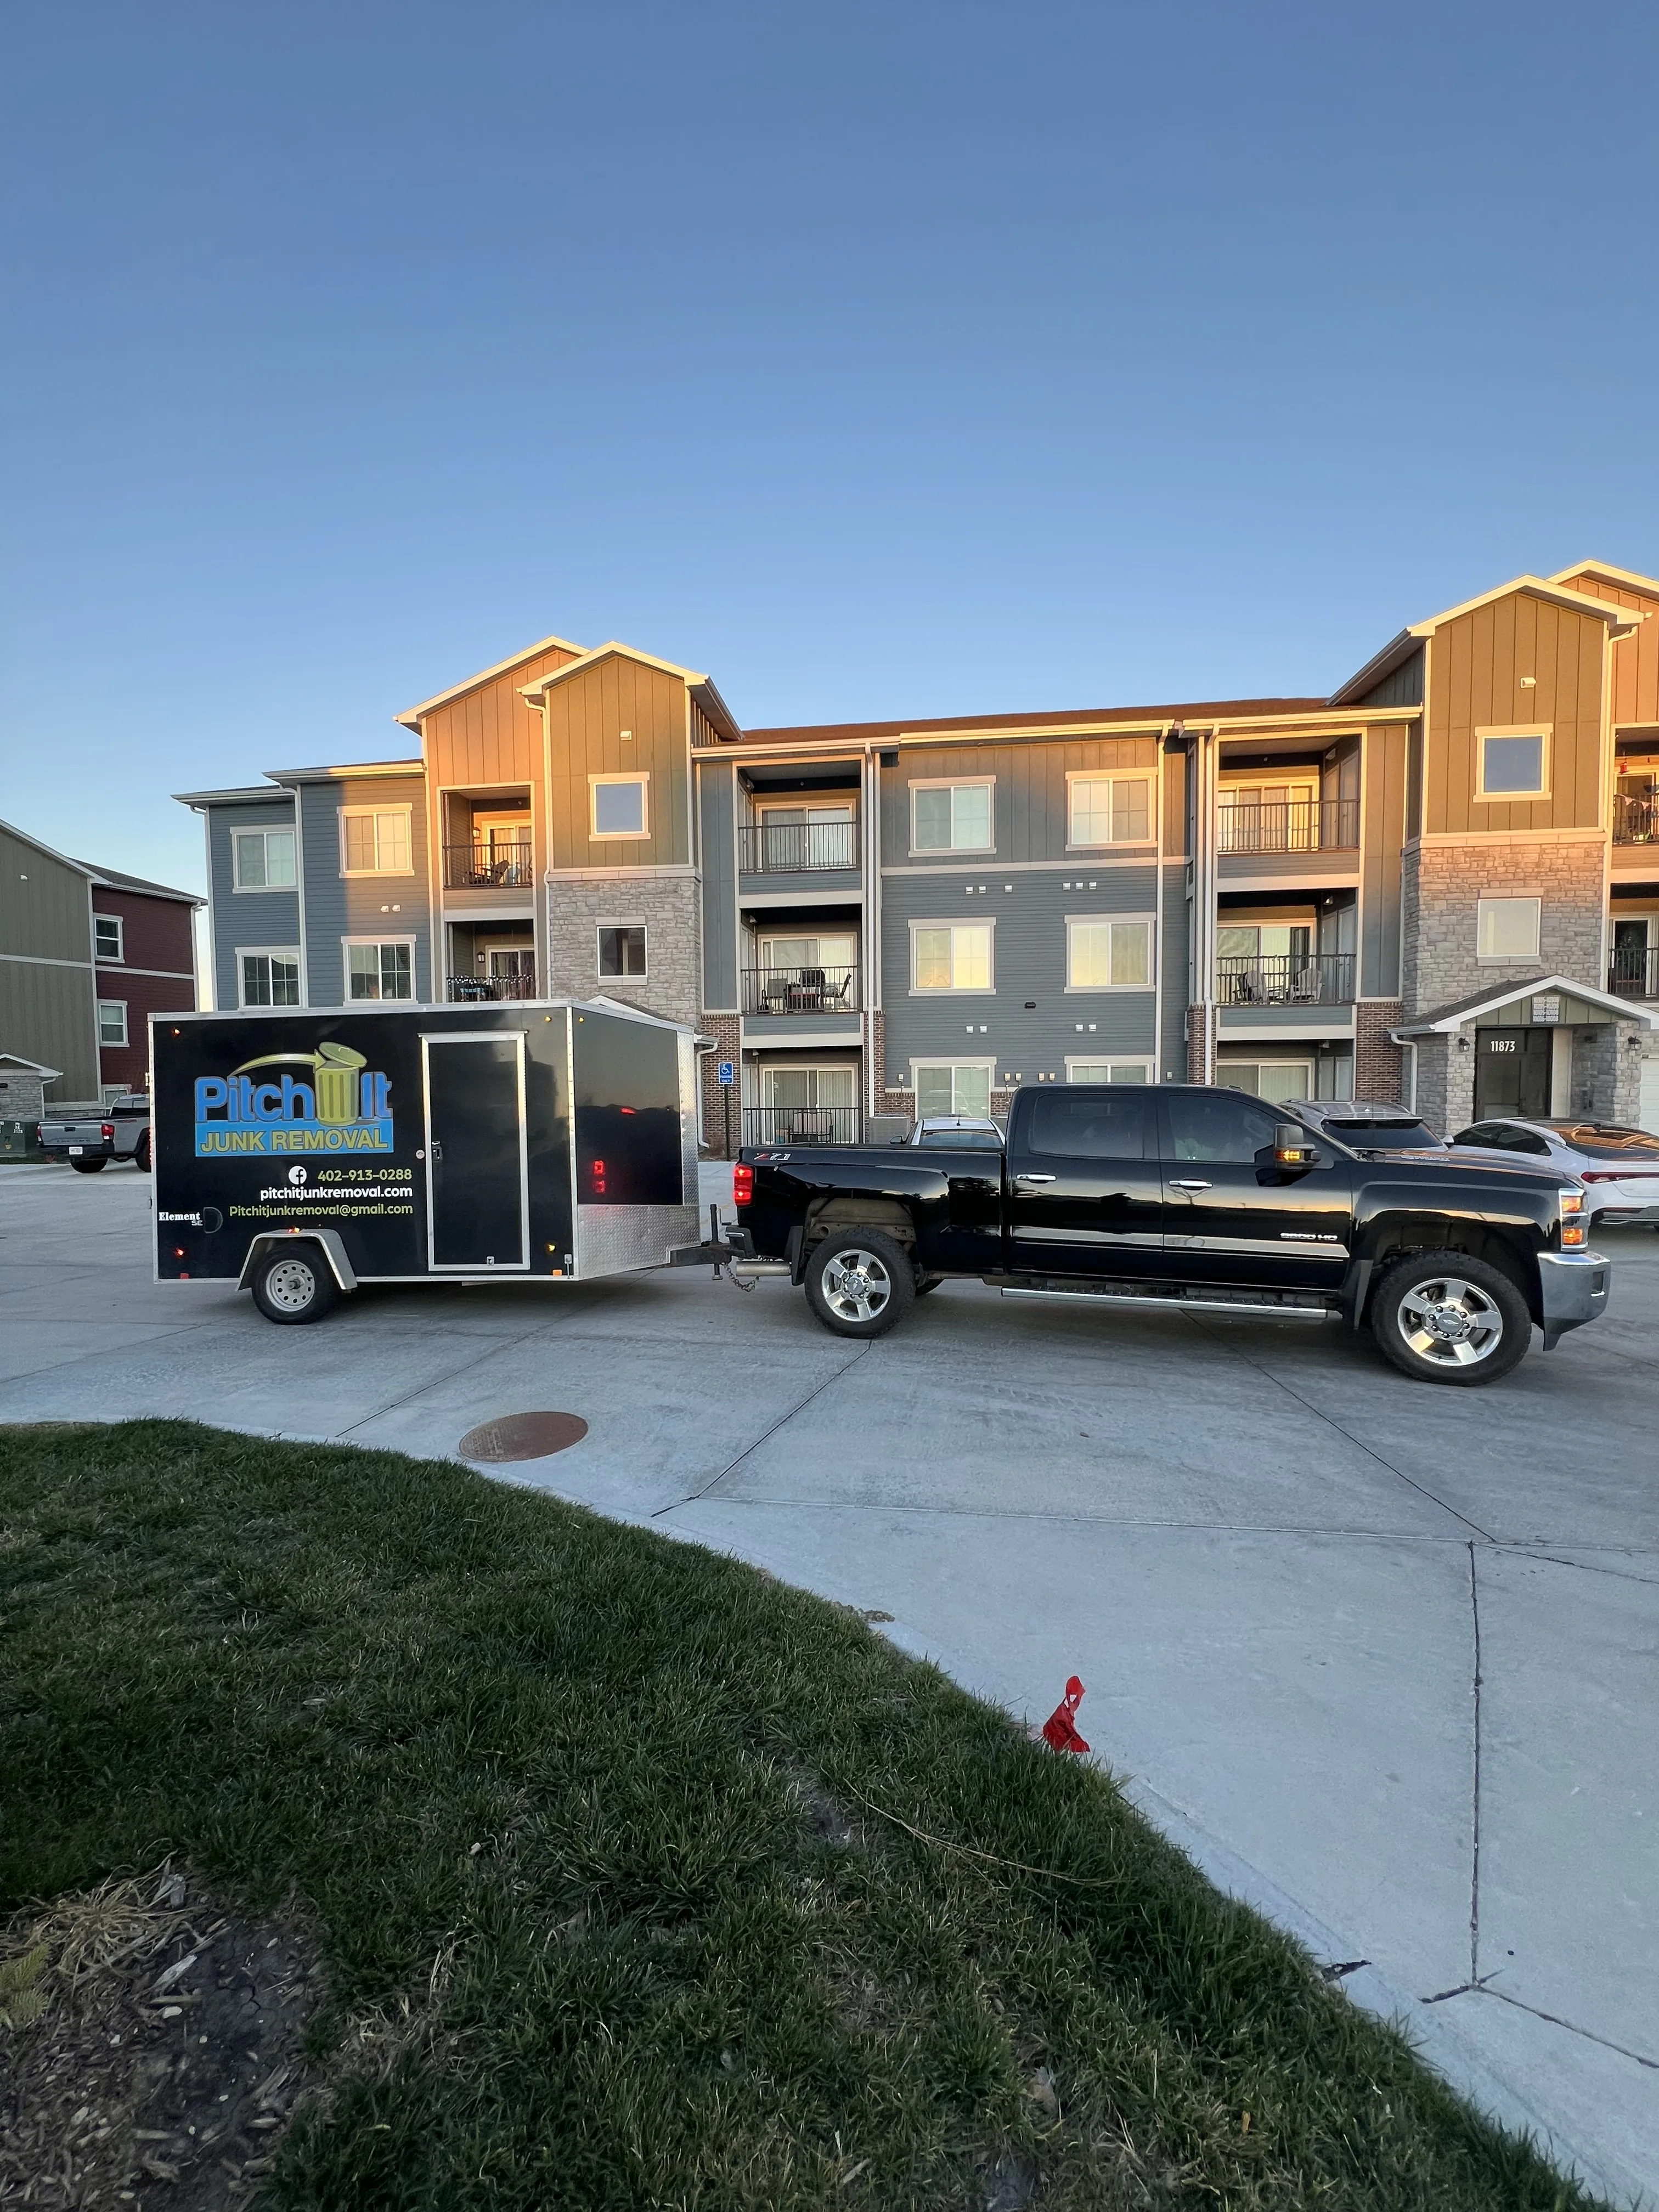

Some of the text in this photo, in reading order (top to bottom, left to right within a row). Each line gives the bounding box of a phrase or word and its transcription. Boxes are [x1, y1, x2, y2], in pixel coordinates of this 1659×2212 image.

[1491, 1041, 1515, 1052] 11873
[195, 1071, 392, 1123] Pitch It
[201, 1128, 388, 1153] JUNK REMOVAL
[317, 1169, 413, 1181] 402-913-0288
[260, 1186, 413, 1201] pitchitjunkremoval.com
[159, 1211, 201, 1221] Element
[229, 1203, 413, 1217] Pitchitjunkremoval@gmail.com
